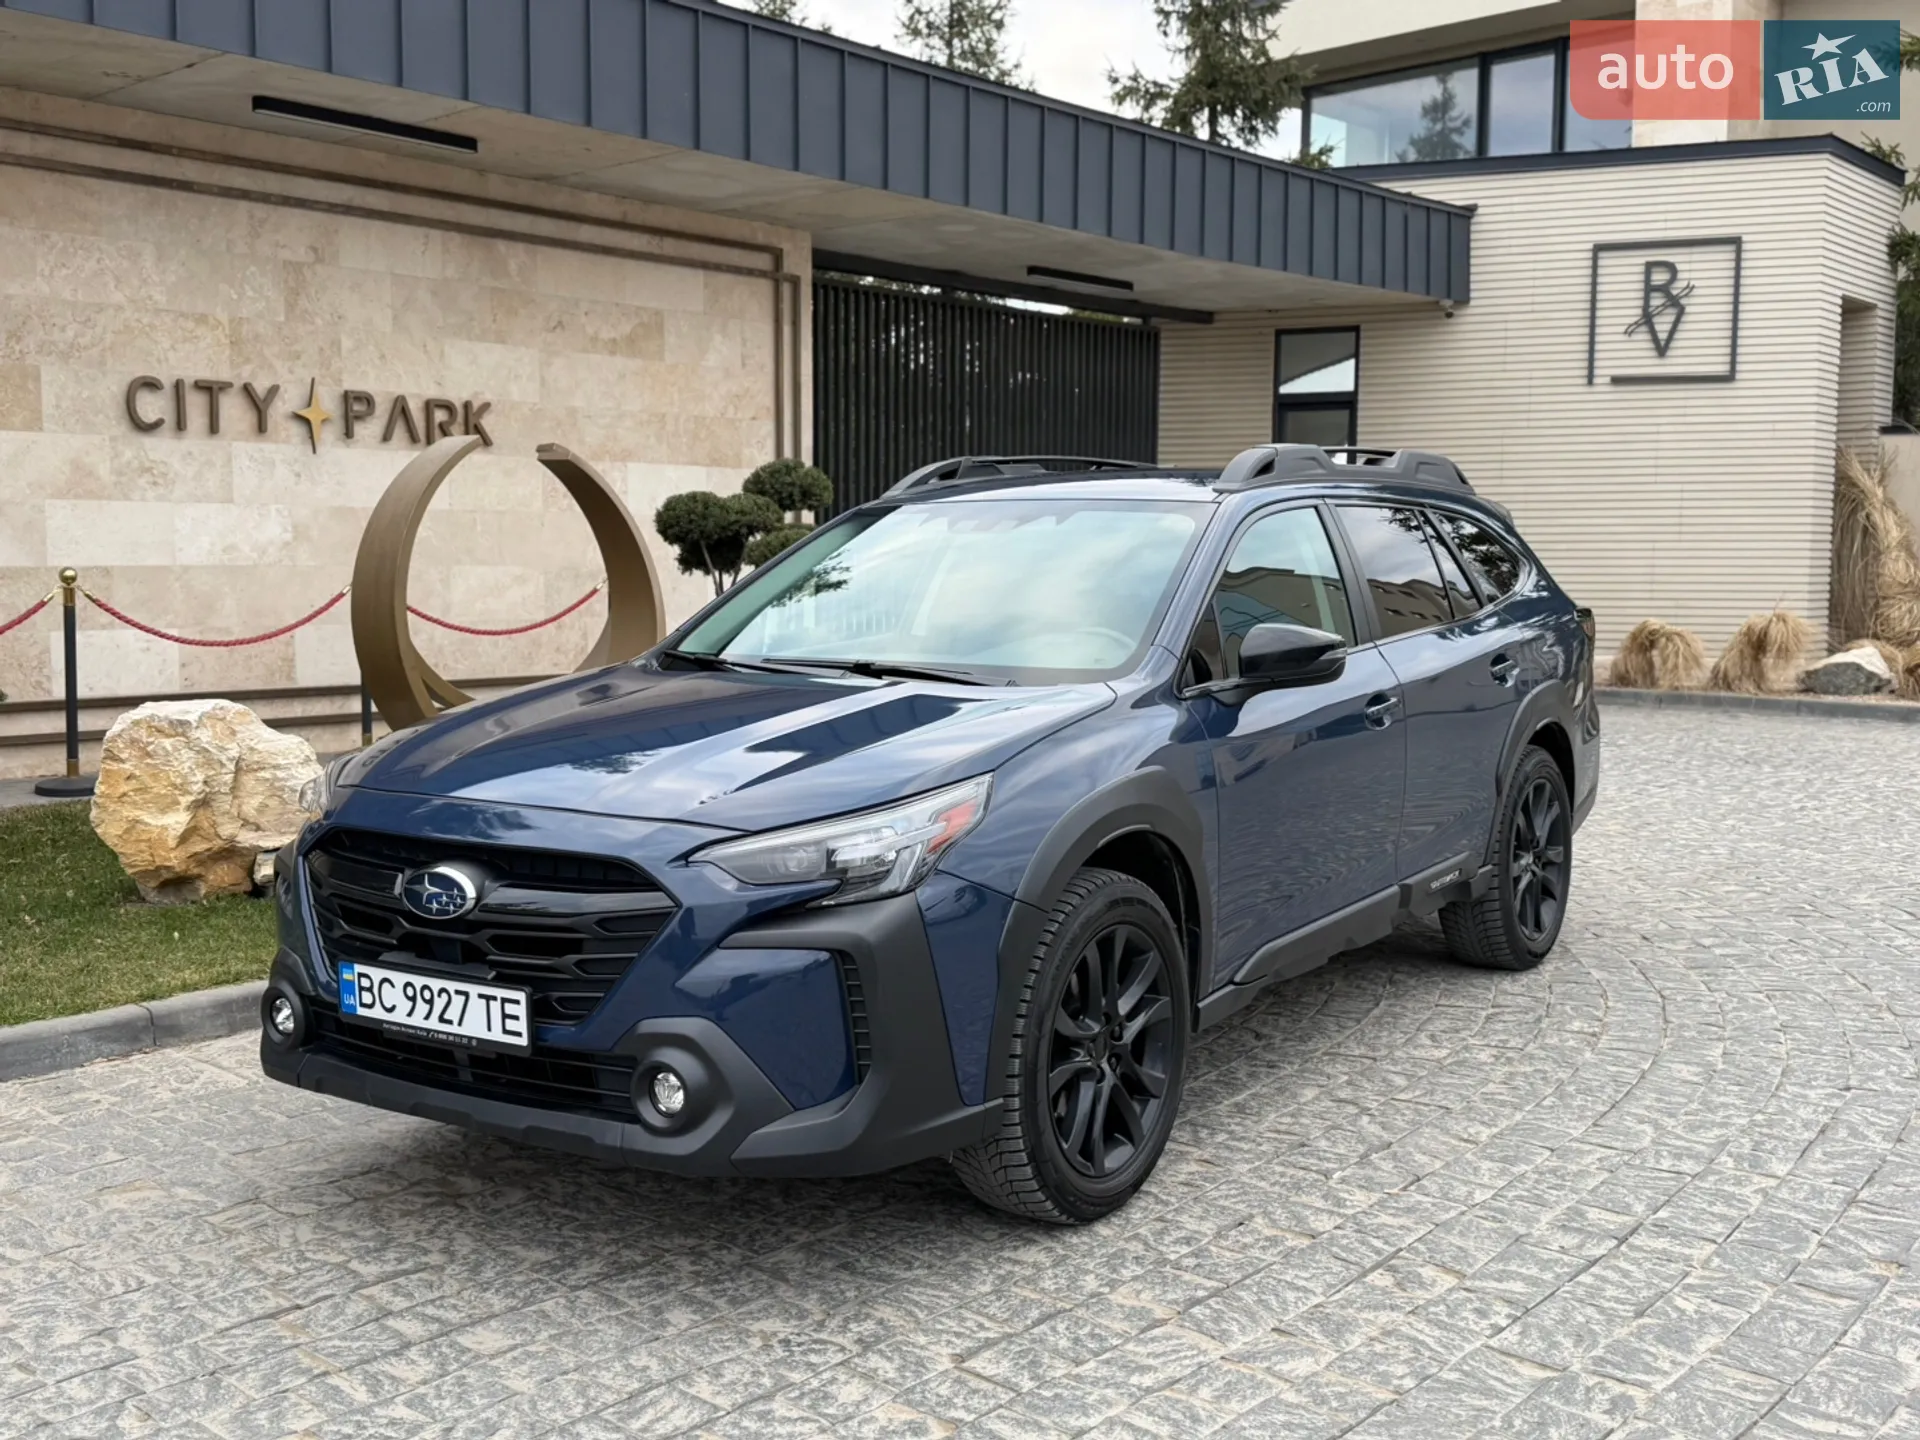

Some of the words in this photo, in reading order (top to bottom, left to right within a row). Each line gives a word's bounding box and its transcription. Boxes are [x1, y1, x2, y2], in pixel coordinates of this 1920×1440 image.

[126, 375, 281, 434] CITY
[343, 388, 494, 447] PARK
[344, 993, 356, 1007] UA
[357, 972, 397, 1014] BC
[402, 980, 470, 1028] 9927
[477, 992, 524, 1039] TE
